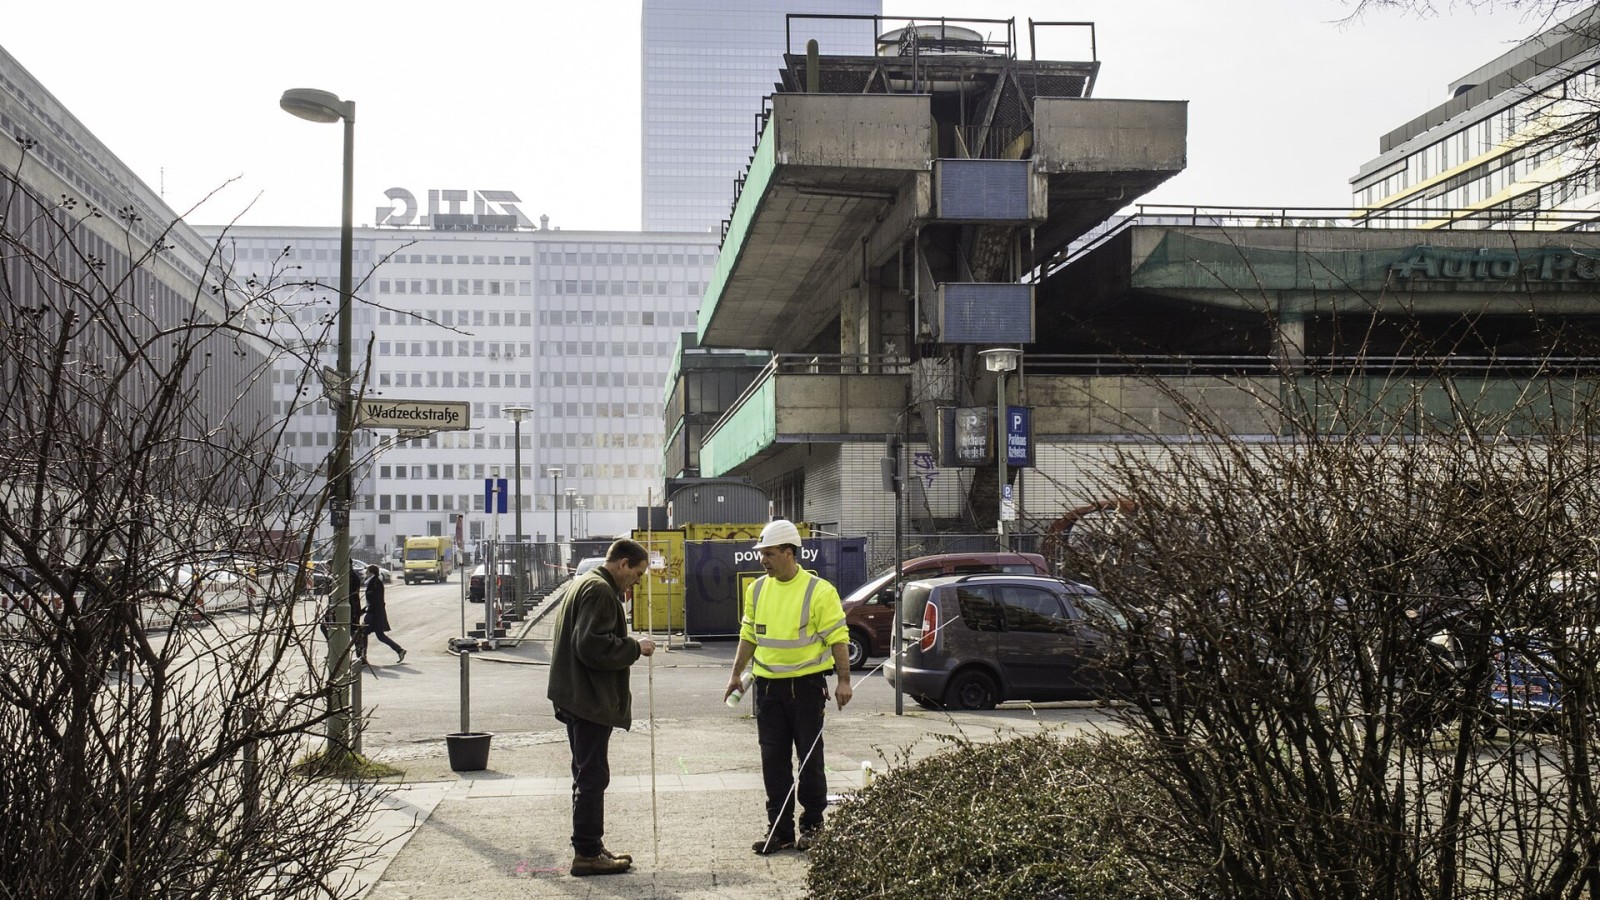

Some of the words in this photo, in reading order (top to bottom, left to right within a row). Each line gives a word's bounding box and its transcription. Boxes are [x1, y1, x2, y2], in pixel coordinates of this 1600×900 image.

[368, 404, 459, 423] Wadzeckstraße
[1014, 415, 1021, 430] P
[801, 546, 819, 562] by
